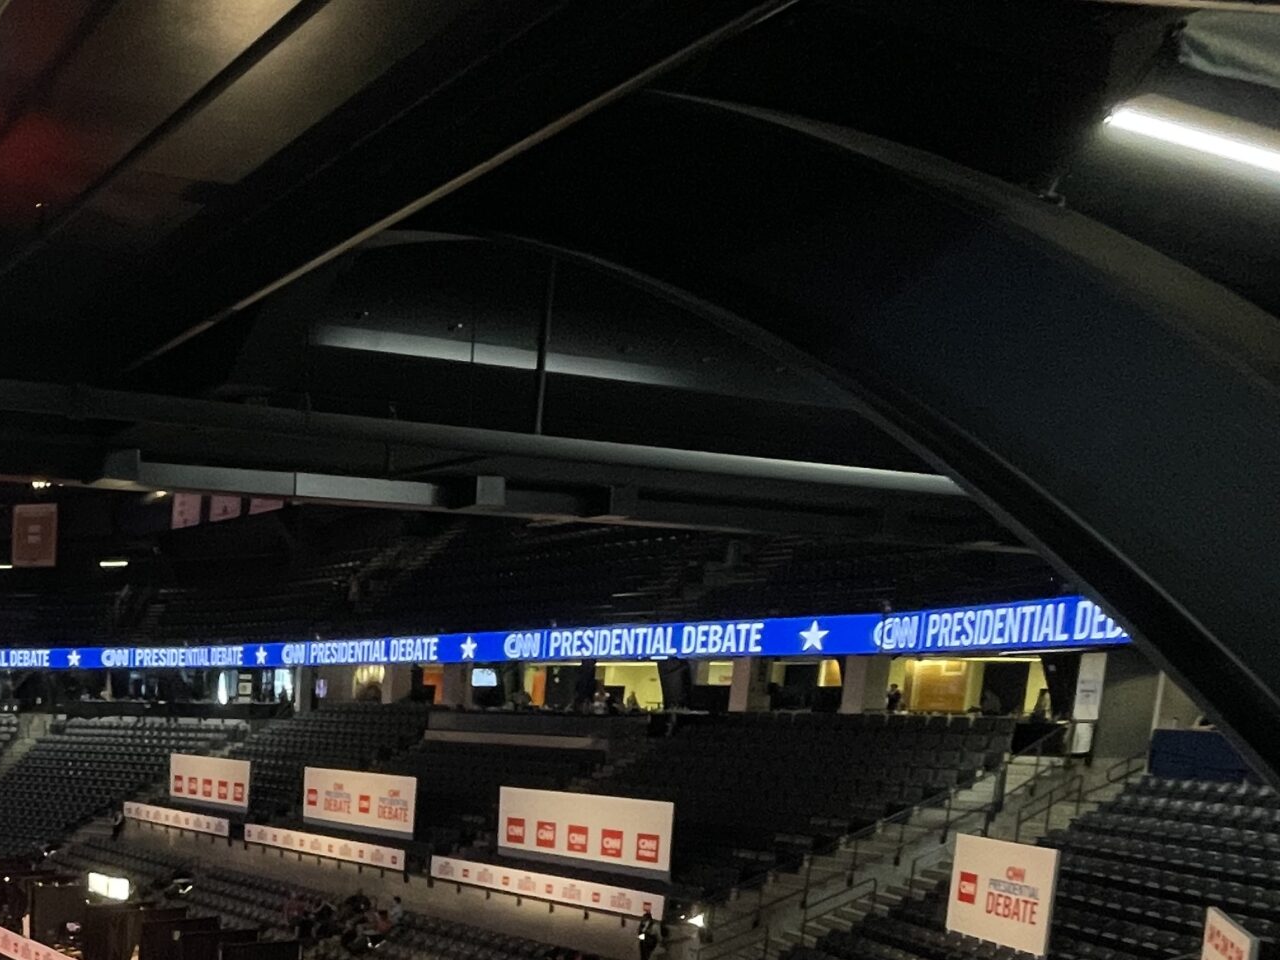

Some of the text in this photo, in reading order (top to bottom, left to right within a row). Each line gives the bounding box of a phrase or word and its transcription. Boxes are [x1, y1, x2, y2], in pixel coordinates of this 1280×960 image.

[873, 614, 919, 650] CNN
[926, 602, 1069, 648] PRESIDENTIAL
[281, 637, 439, 664] CNN PRESIDENTIAL DEBATE
[504, 623, 762, 659] CNN PRESIDENTIAL DEBATE
[10, 650, 50, 667] DEBATE
[101, 646, 243, 667] CNN PRESIDENTIAL DEBATE
[323, 798, 351, 815] DEBATE
[377, 805, 408, 823] DEBATE
[986, 891, 1038, 925] DEBATE
